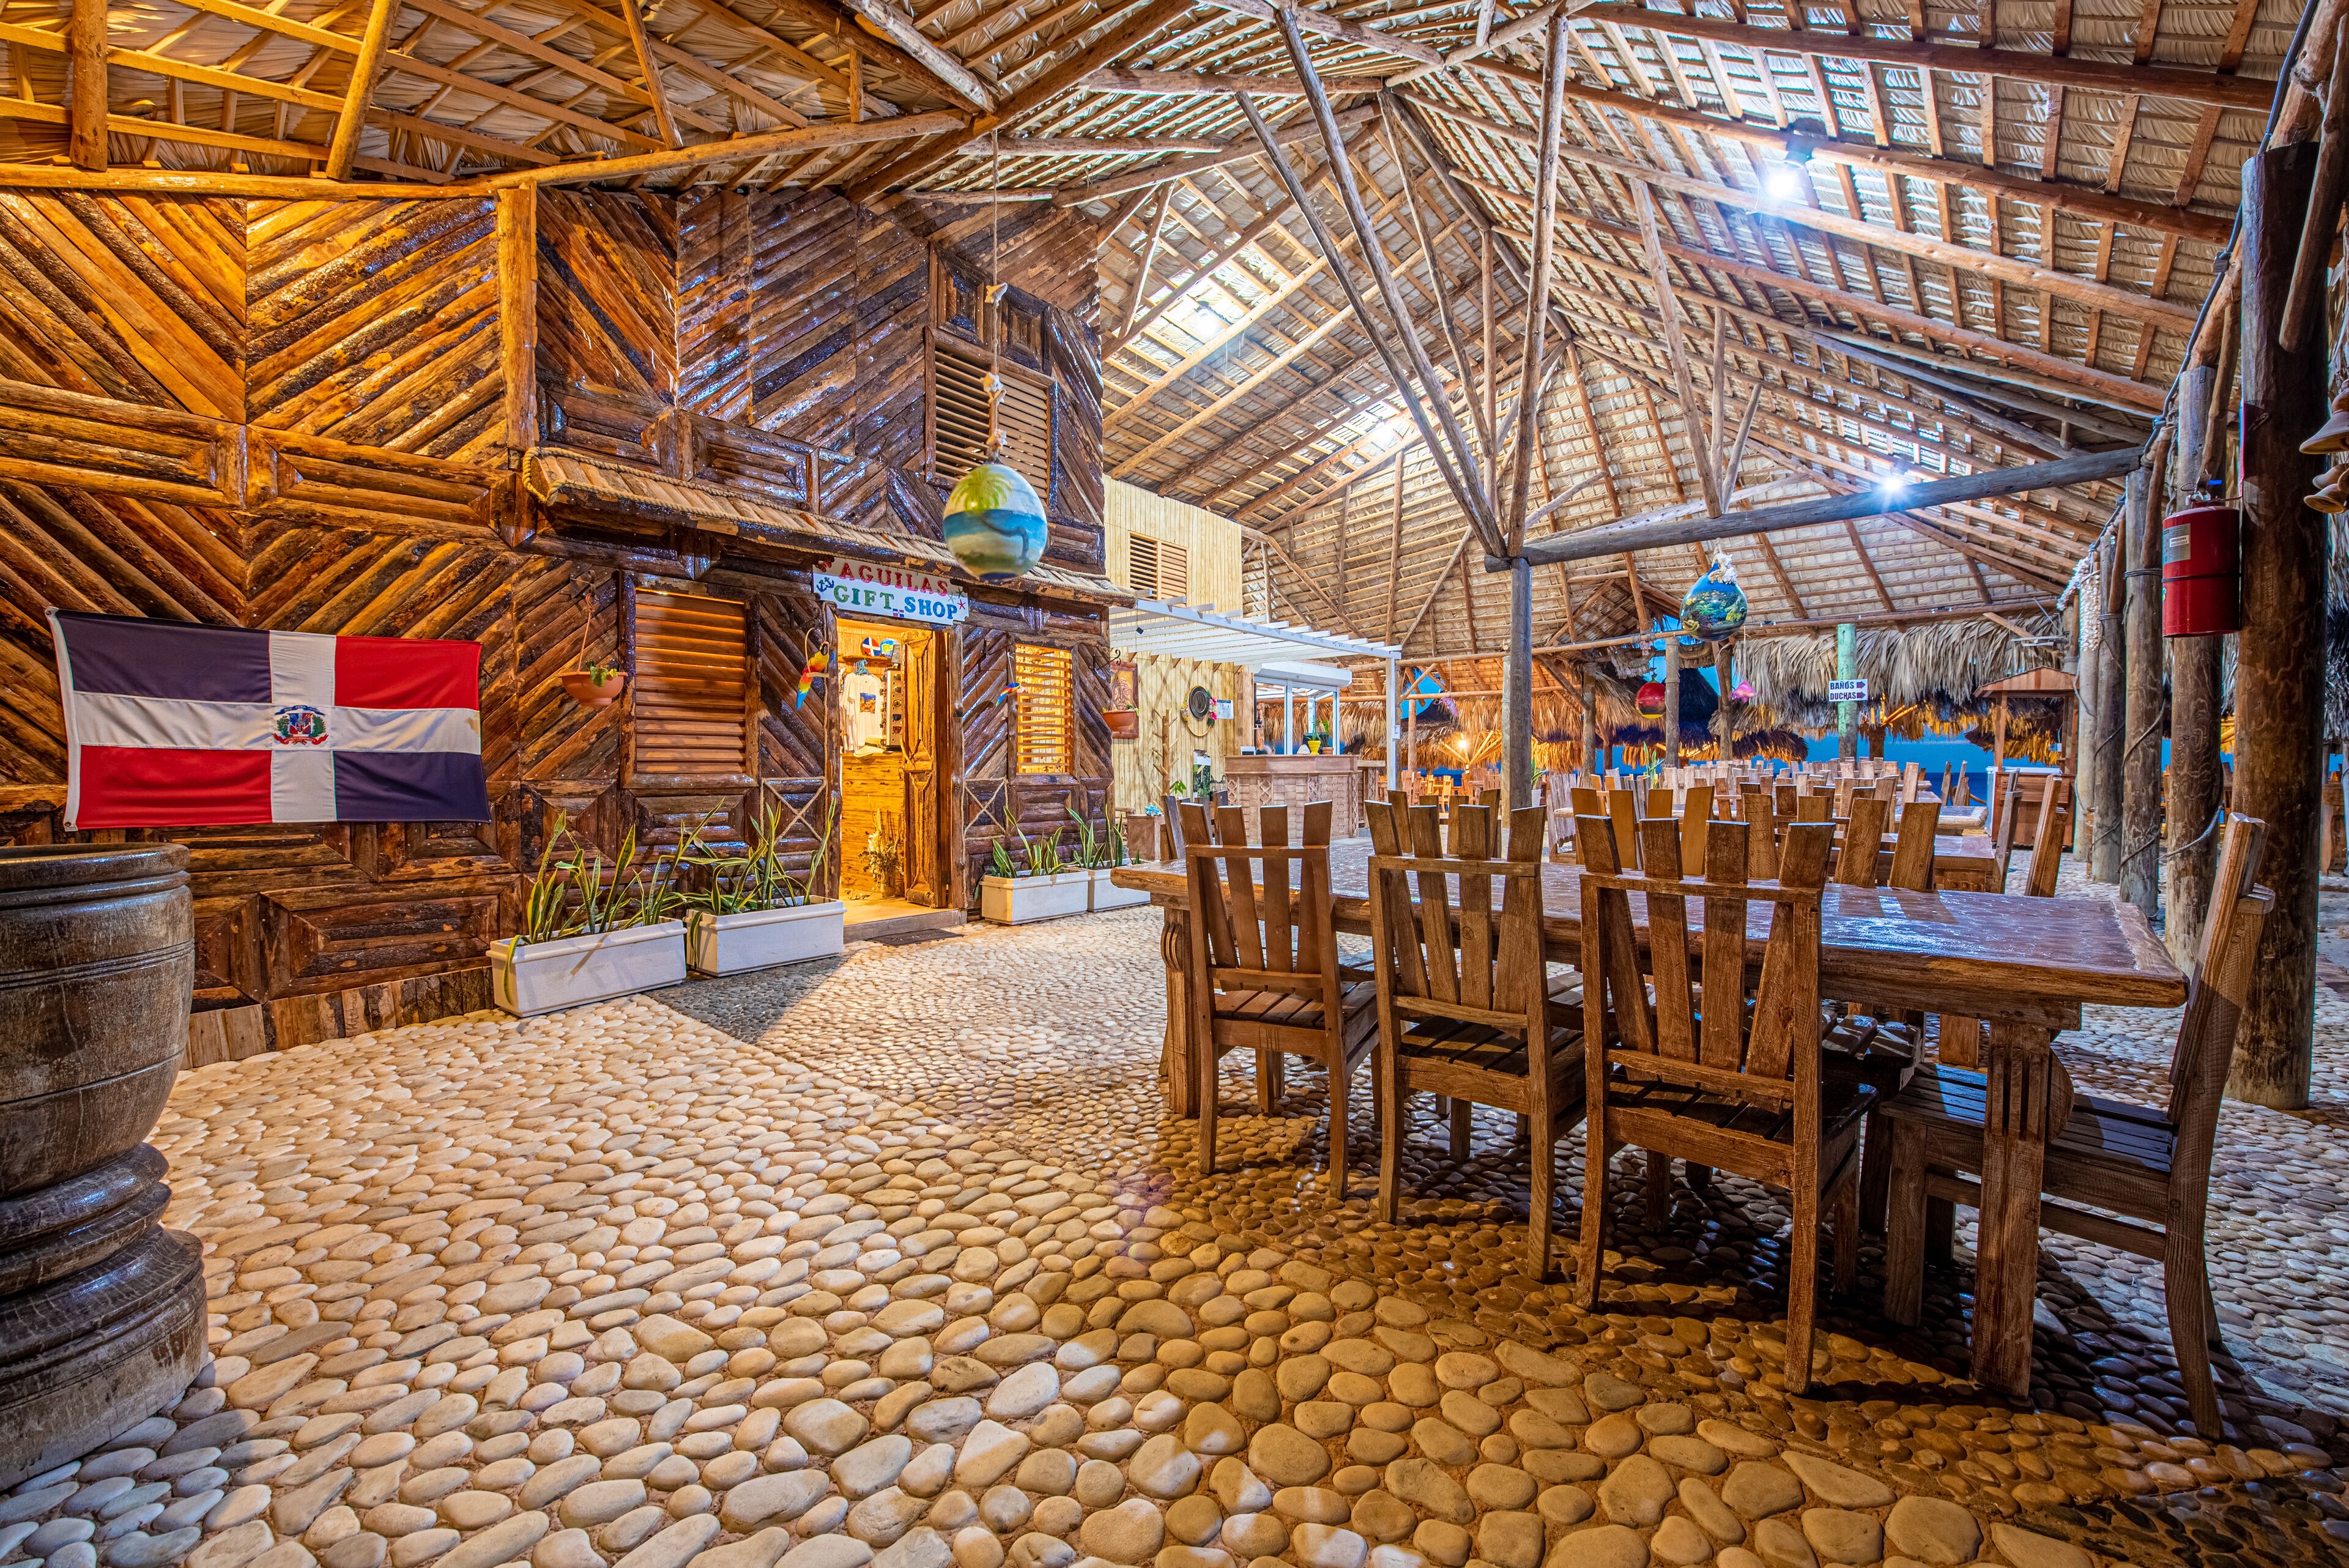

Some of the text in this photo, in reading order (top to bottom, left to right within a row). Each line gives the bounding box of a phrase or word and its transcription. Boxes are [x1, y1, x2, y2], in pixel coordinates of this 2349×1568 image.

[839, 562, 948, 596] AGUILAS
[833, 585, 957, 619] GIFT SHOP
